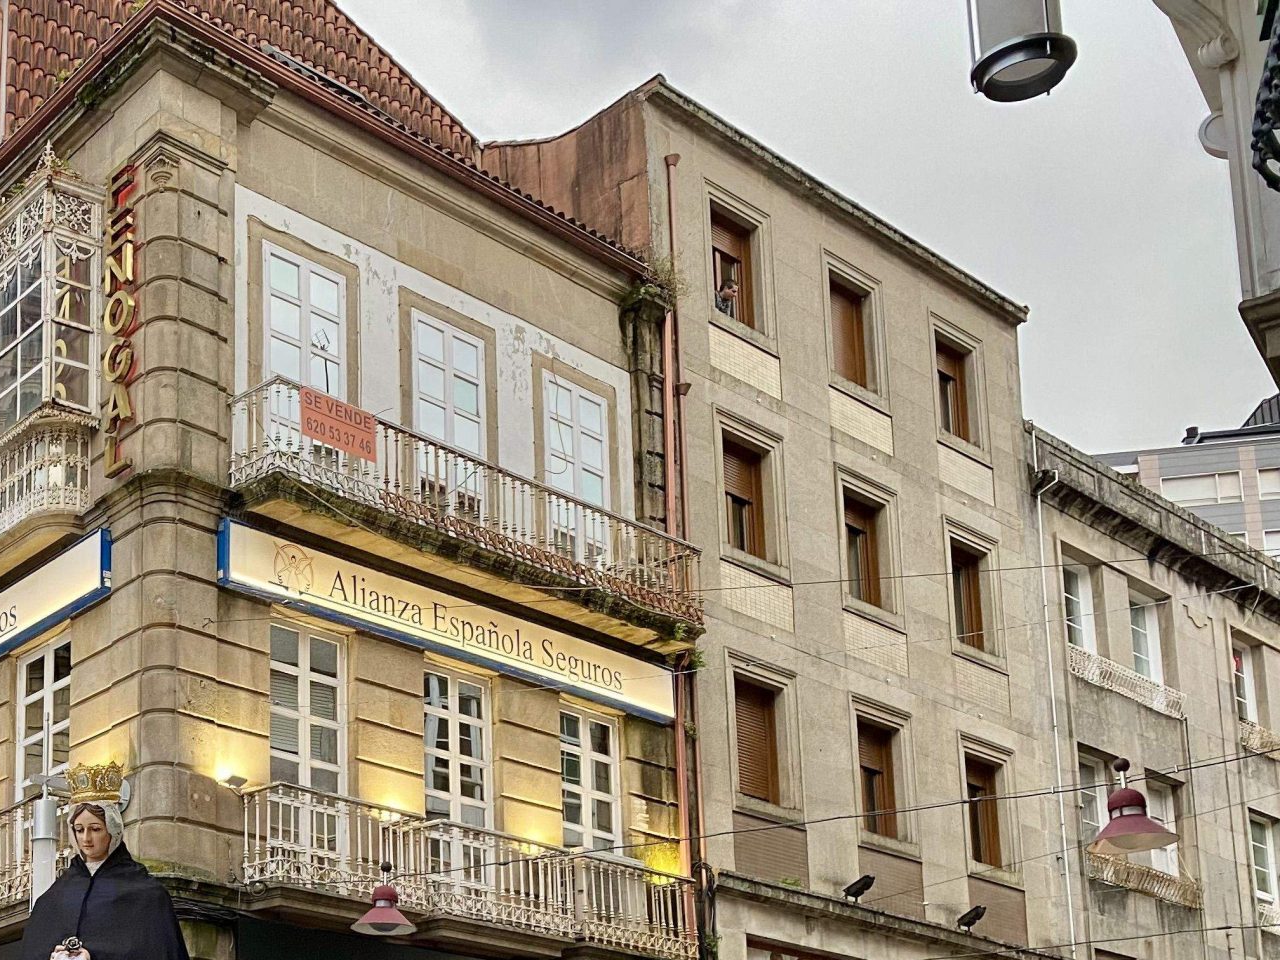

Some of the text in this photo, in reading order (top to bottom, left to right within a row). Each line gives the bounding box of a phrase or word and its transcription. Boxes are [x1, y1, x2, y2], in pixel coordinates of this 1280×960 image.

[305, 392, 372, 429] SE VENDE
[306, 416, 371, 454] 620 53 37 46
[329, 570, 623, 690] Alianza Española Seguros
